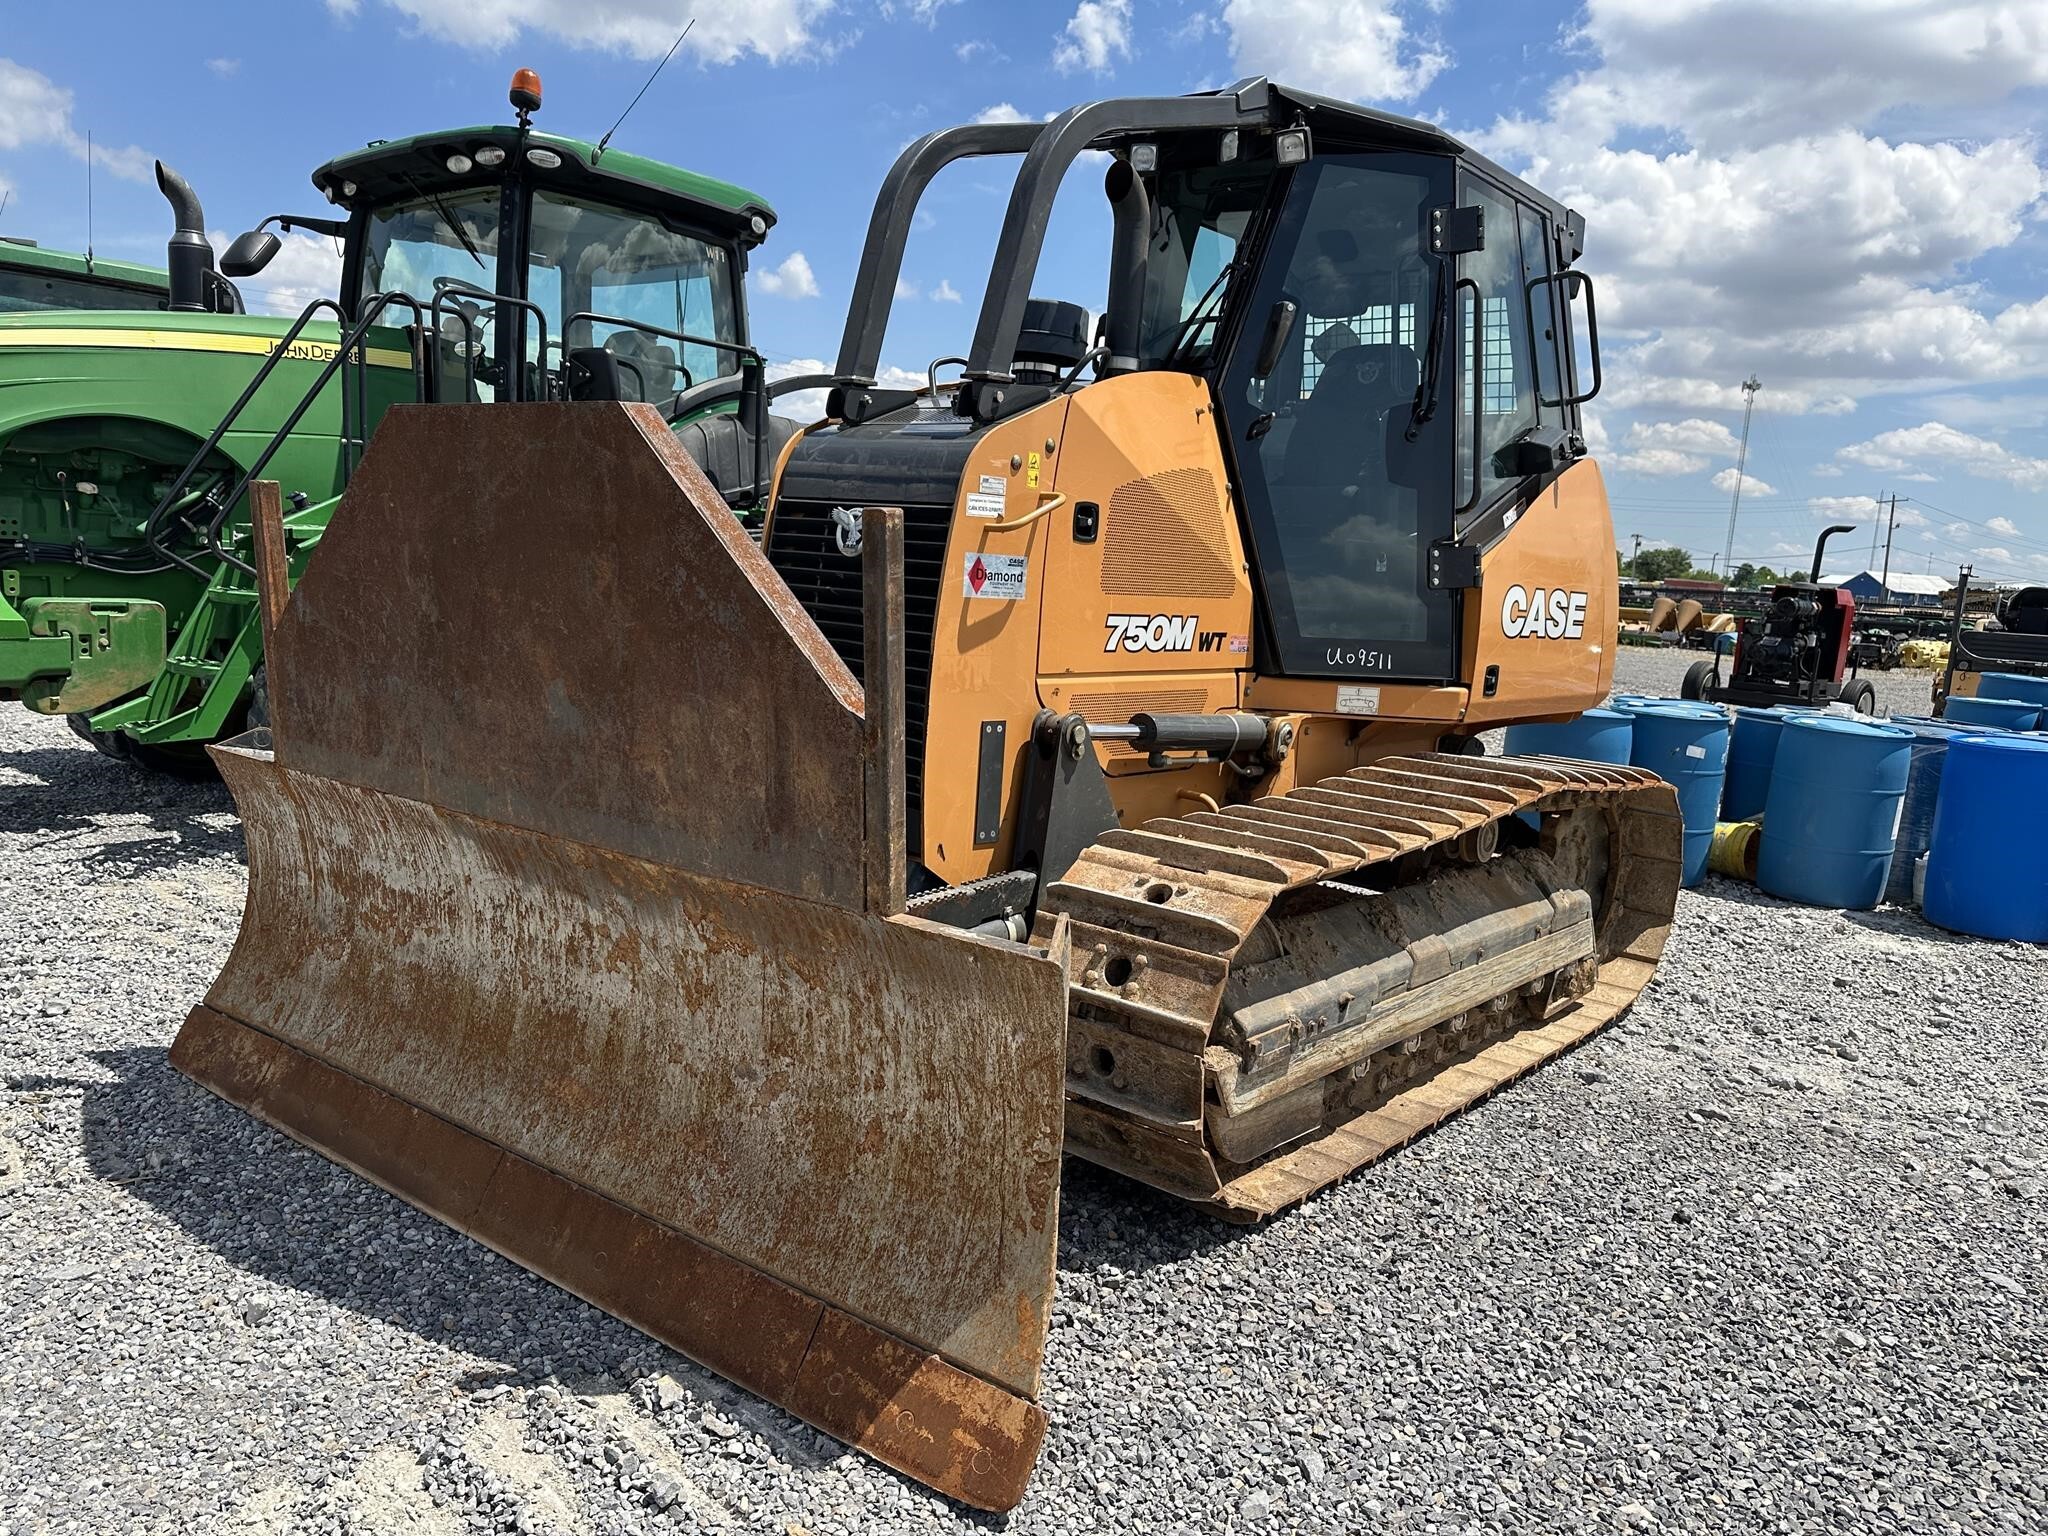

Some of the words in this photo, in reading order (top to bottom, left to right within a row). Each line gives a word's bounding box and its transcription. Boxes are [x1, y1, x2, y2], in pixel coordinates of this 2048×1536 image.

[976, 568, 1023, 583] Diamond
[1501, 584, 1588, 639] CASE
[1104, 614, 1199, 653] 750M
[1198, 632, 1228, 652] WT
